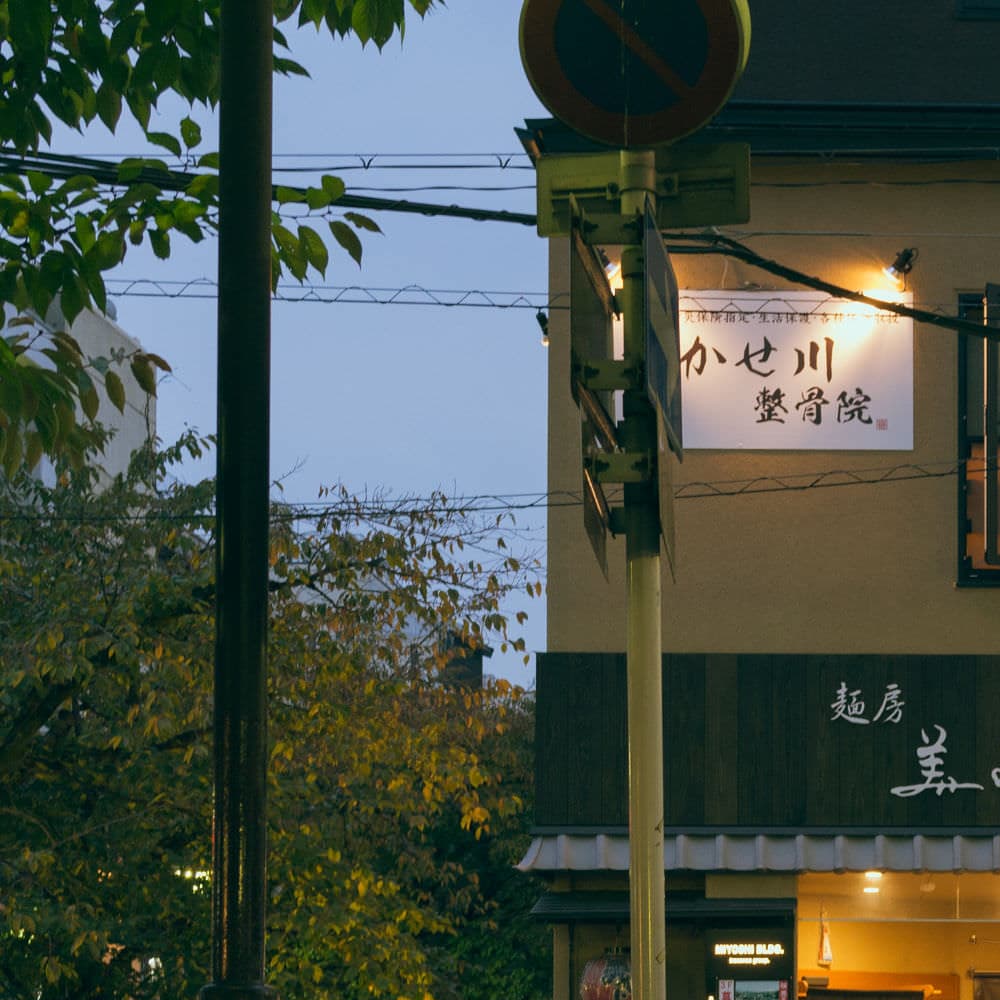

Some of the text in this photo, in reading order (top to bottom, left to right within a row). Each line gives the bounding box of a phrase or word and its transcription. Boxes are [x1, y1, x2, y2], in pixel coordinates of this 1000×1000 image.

[680, 335, 834, 383] かせ川
[754, 386, 873, 426] 整骨院
